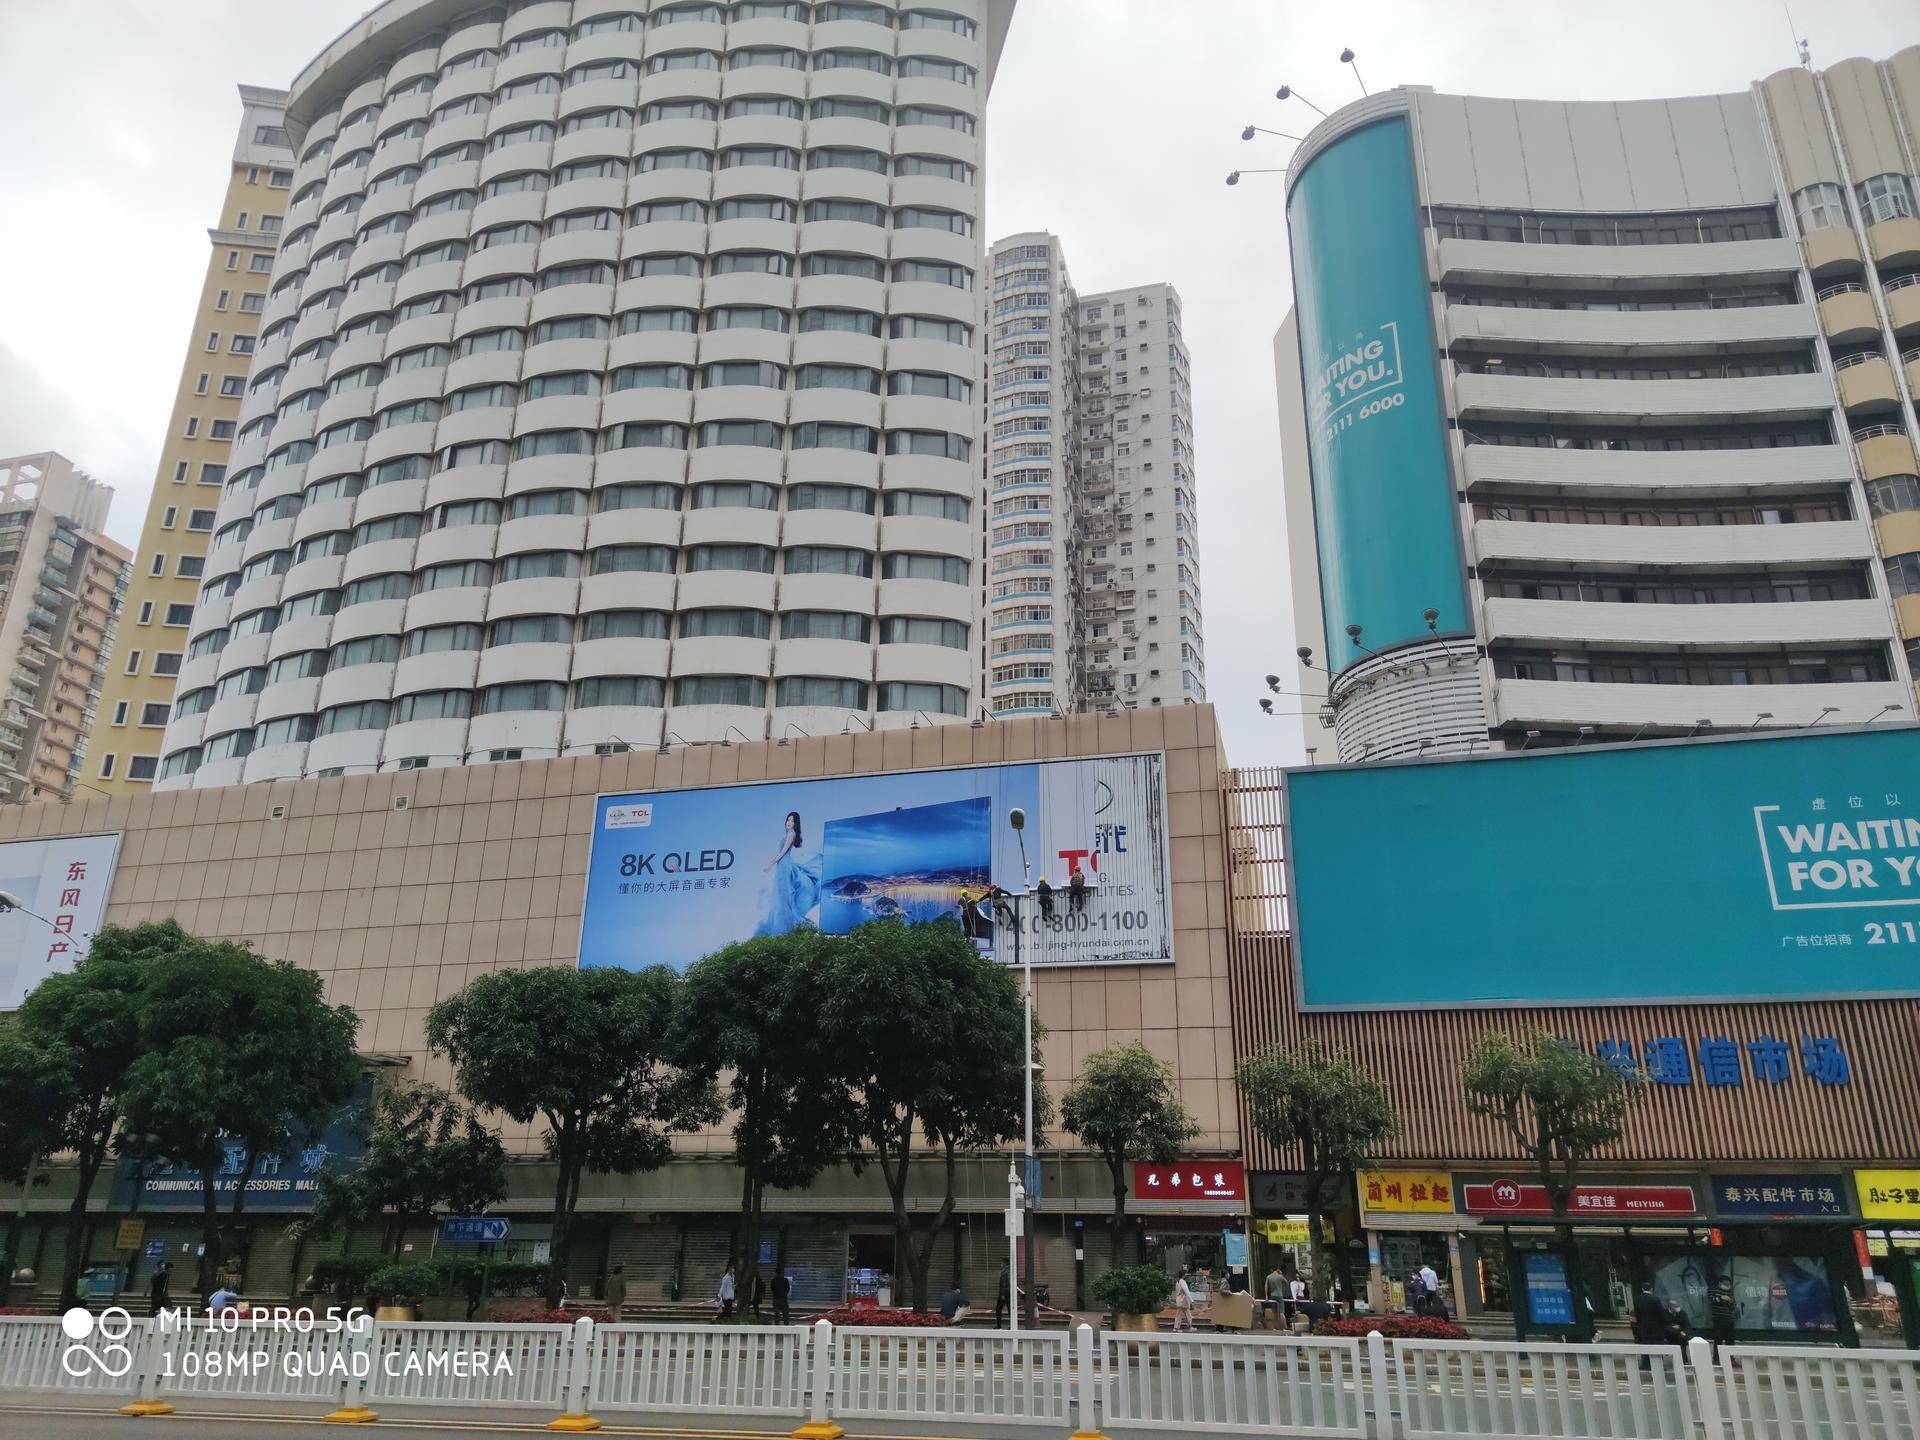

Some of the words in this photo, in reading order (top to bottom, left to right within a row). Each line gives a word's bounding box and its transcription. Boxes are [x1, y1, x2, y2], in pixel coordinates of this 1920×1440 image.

[1335, 360, 1394, 397] YOU.
[1360, 393, 1405, 419] 6000
[1812, 793, 1901, 811] 虚位以
[620, 854, 656, 877] 8K
[662, 849, 735, 874] QLED
[1788, 859, 1880, 891] FOR
[619, 877, 731, 895] 懂你的大屏音画专家
[46, 861, 88, 963] 东风日产
[1781, 934, 1852, 947] 广告位招商
[1577, 1195, 1616, 1208] 美宜佳
[1725, 1187, 1835, 1203] 泰兴配件市场
[1821, 1205, 1841, 1213] 入口
